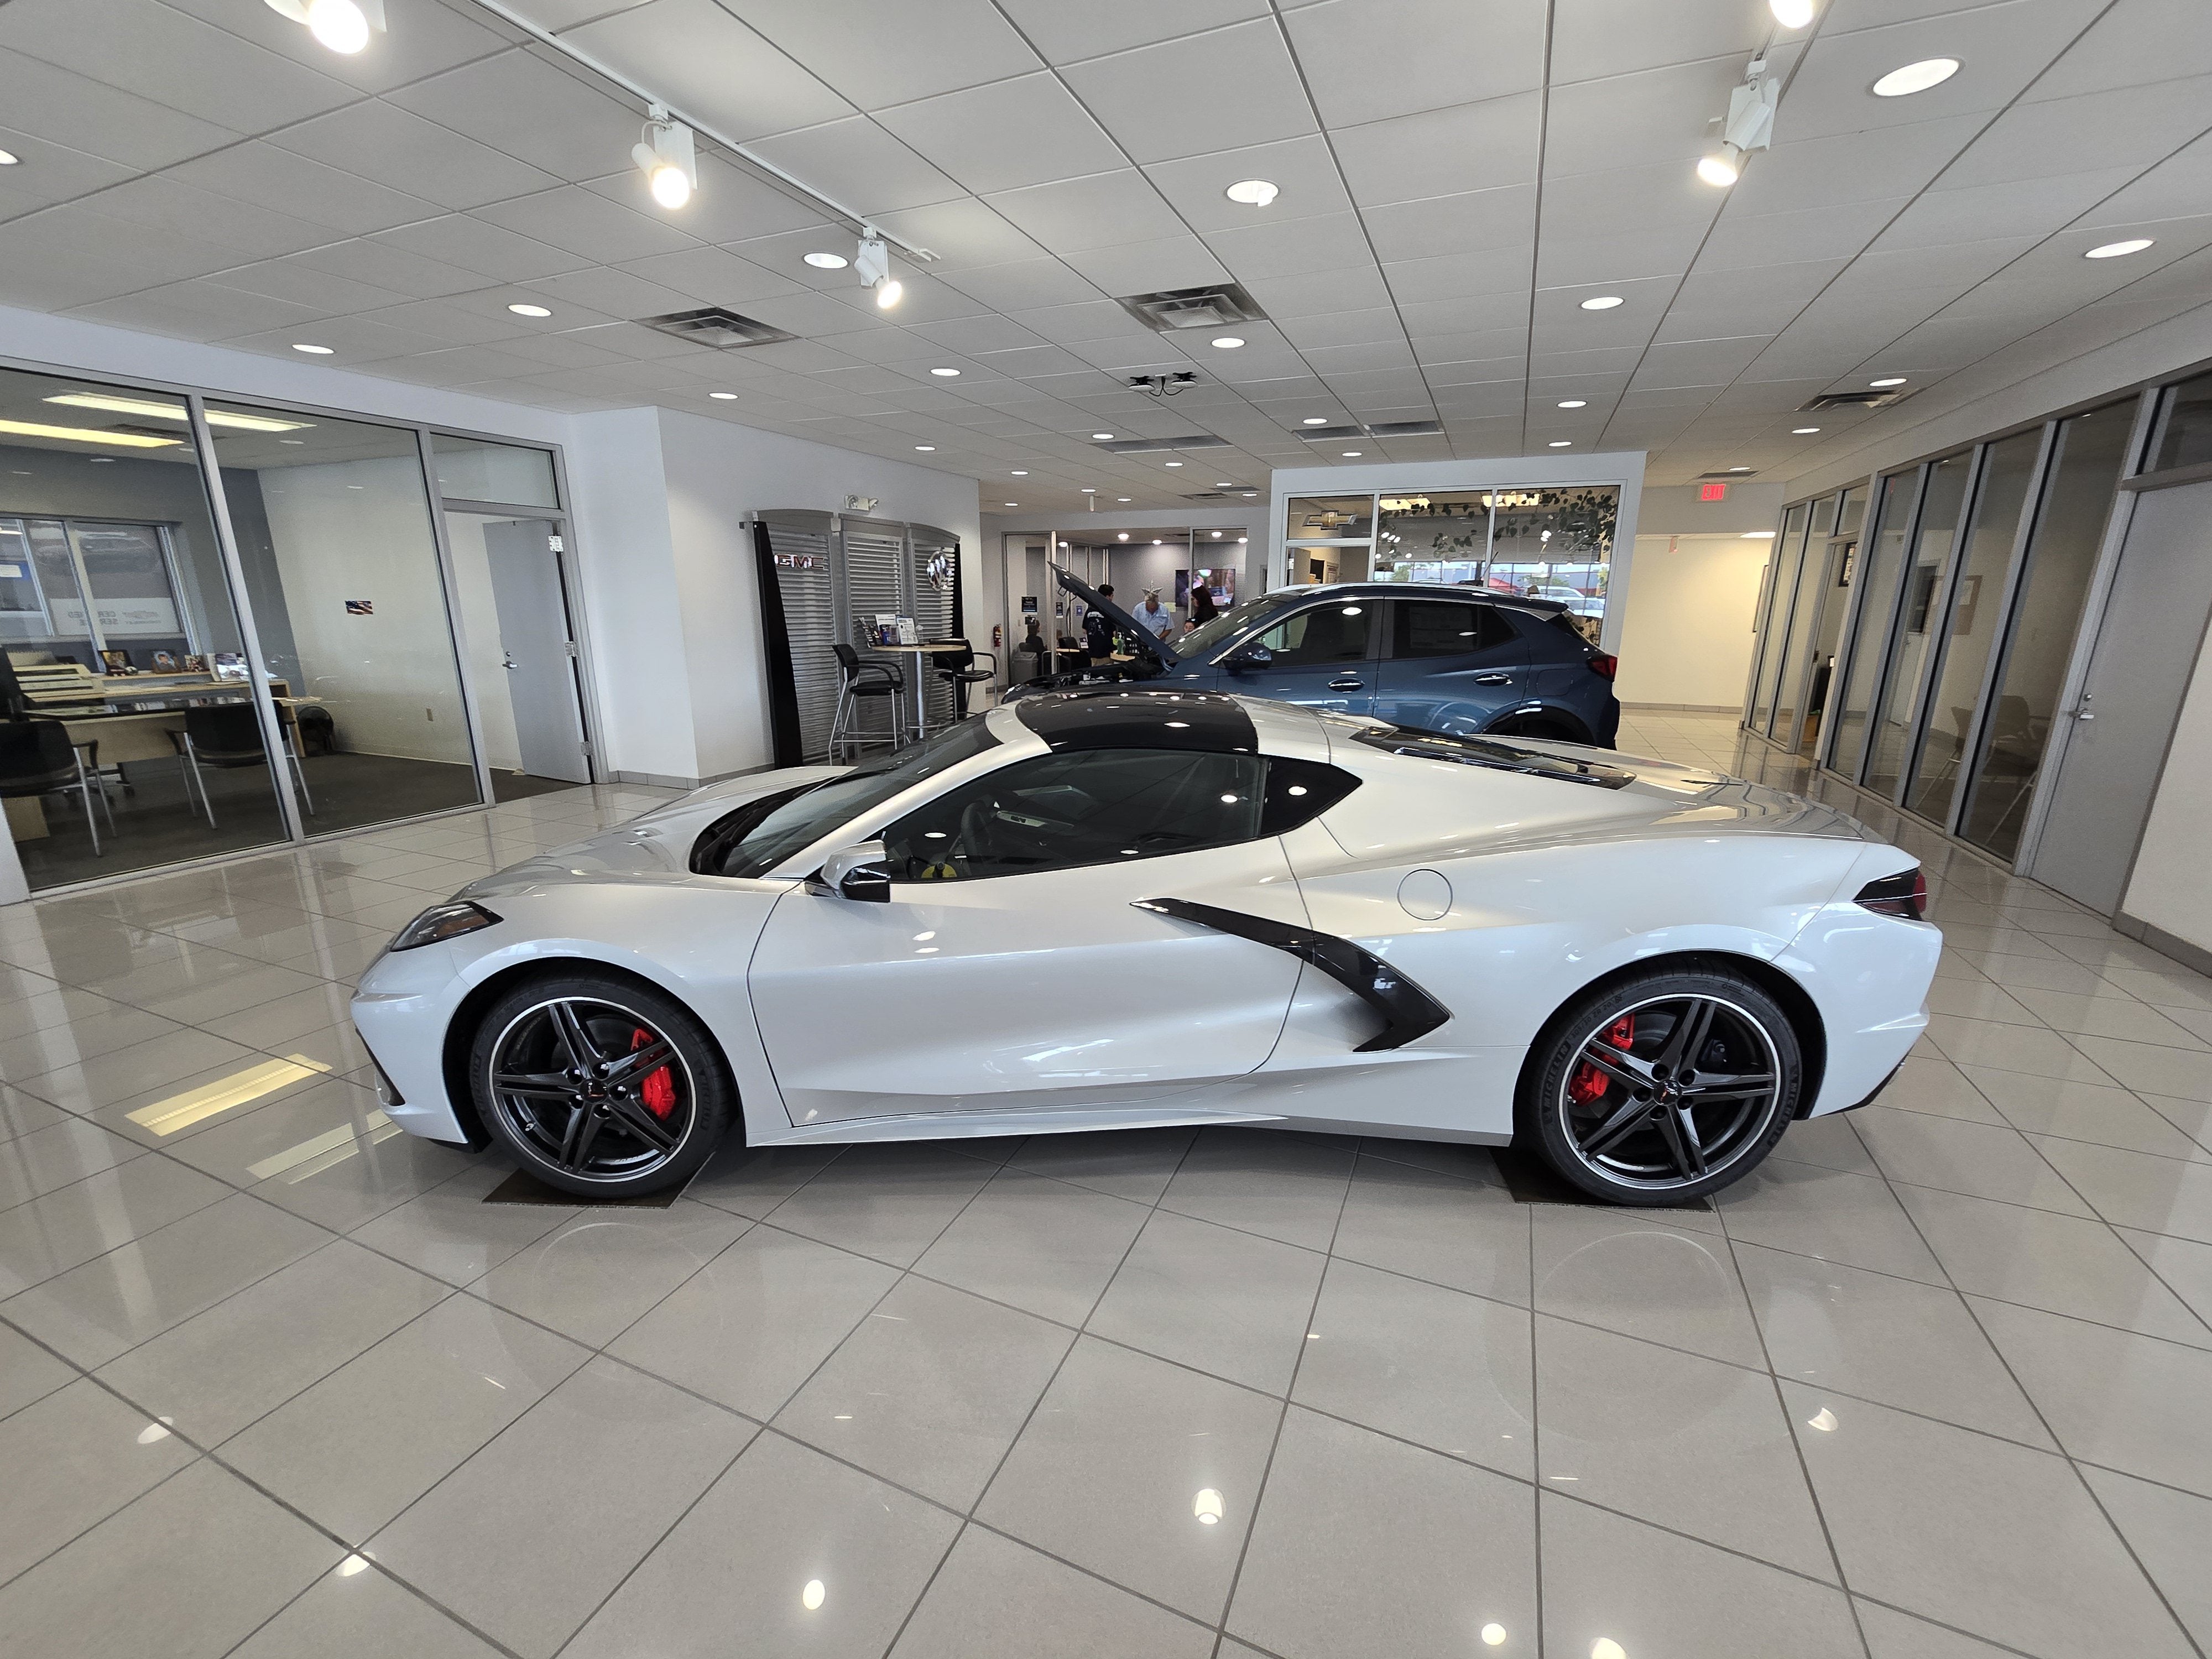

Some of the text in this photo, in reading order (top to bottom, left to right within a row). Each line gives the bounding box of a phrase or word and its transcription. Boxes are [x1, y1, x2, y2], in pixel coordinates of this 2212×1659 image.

[1702, 484, 1725, 500] EXIT
[774, 554, 825, 570] GMC
[1543, 1044, 1569, 1109] MICHELIN
